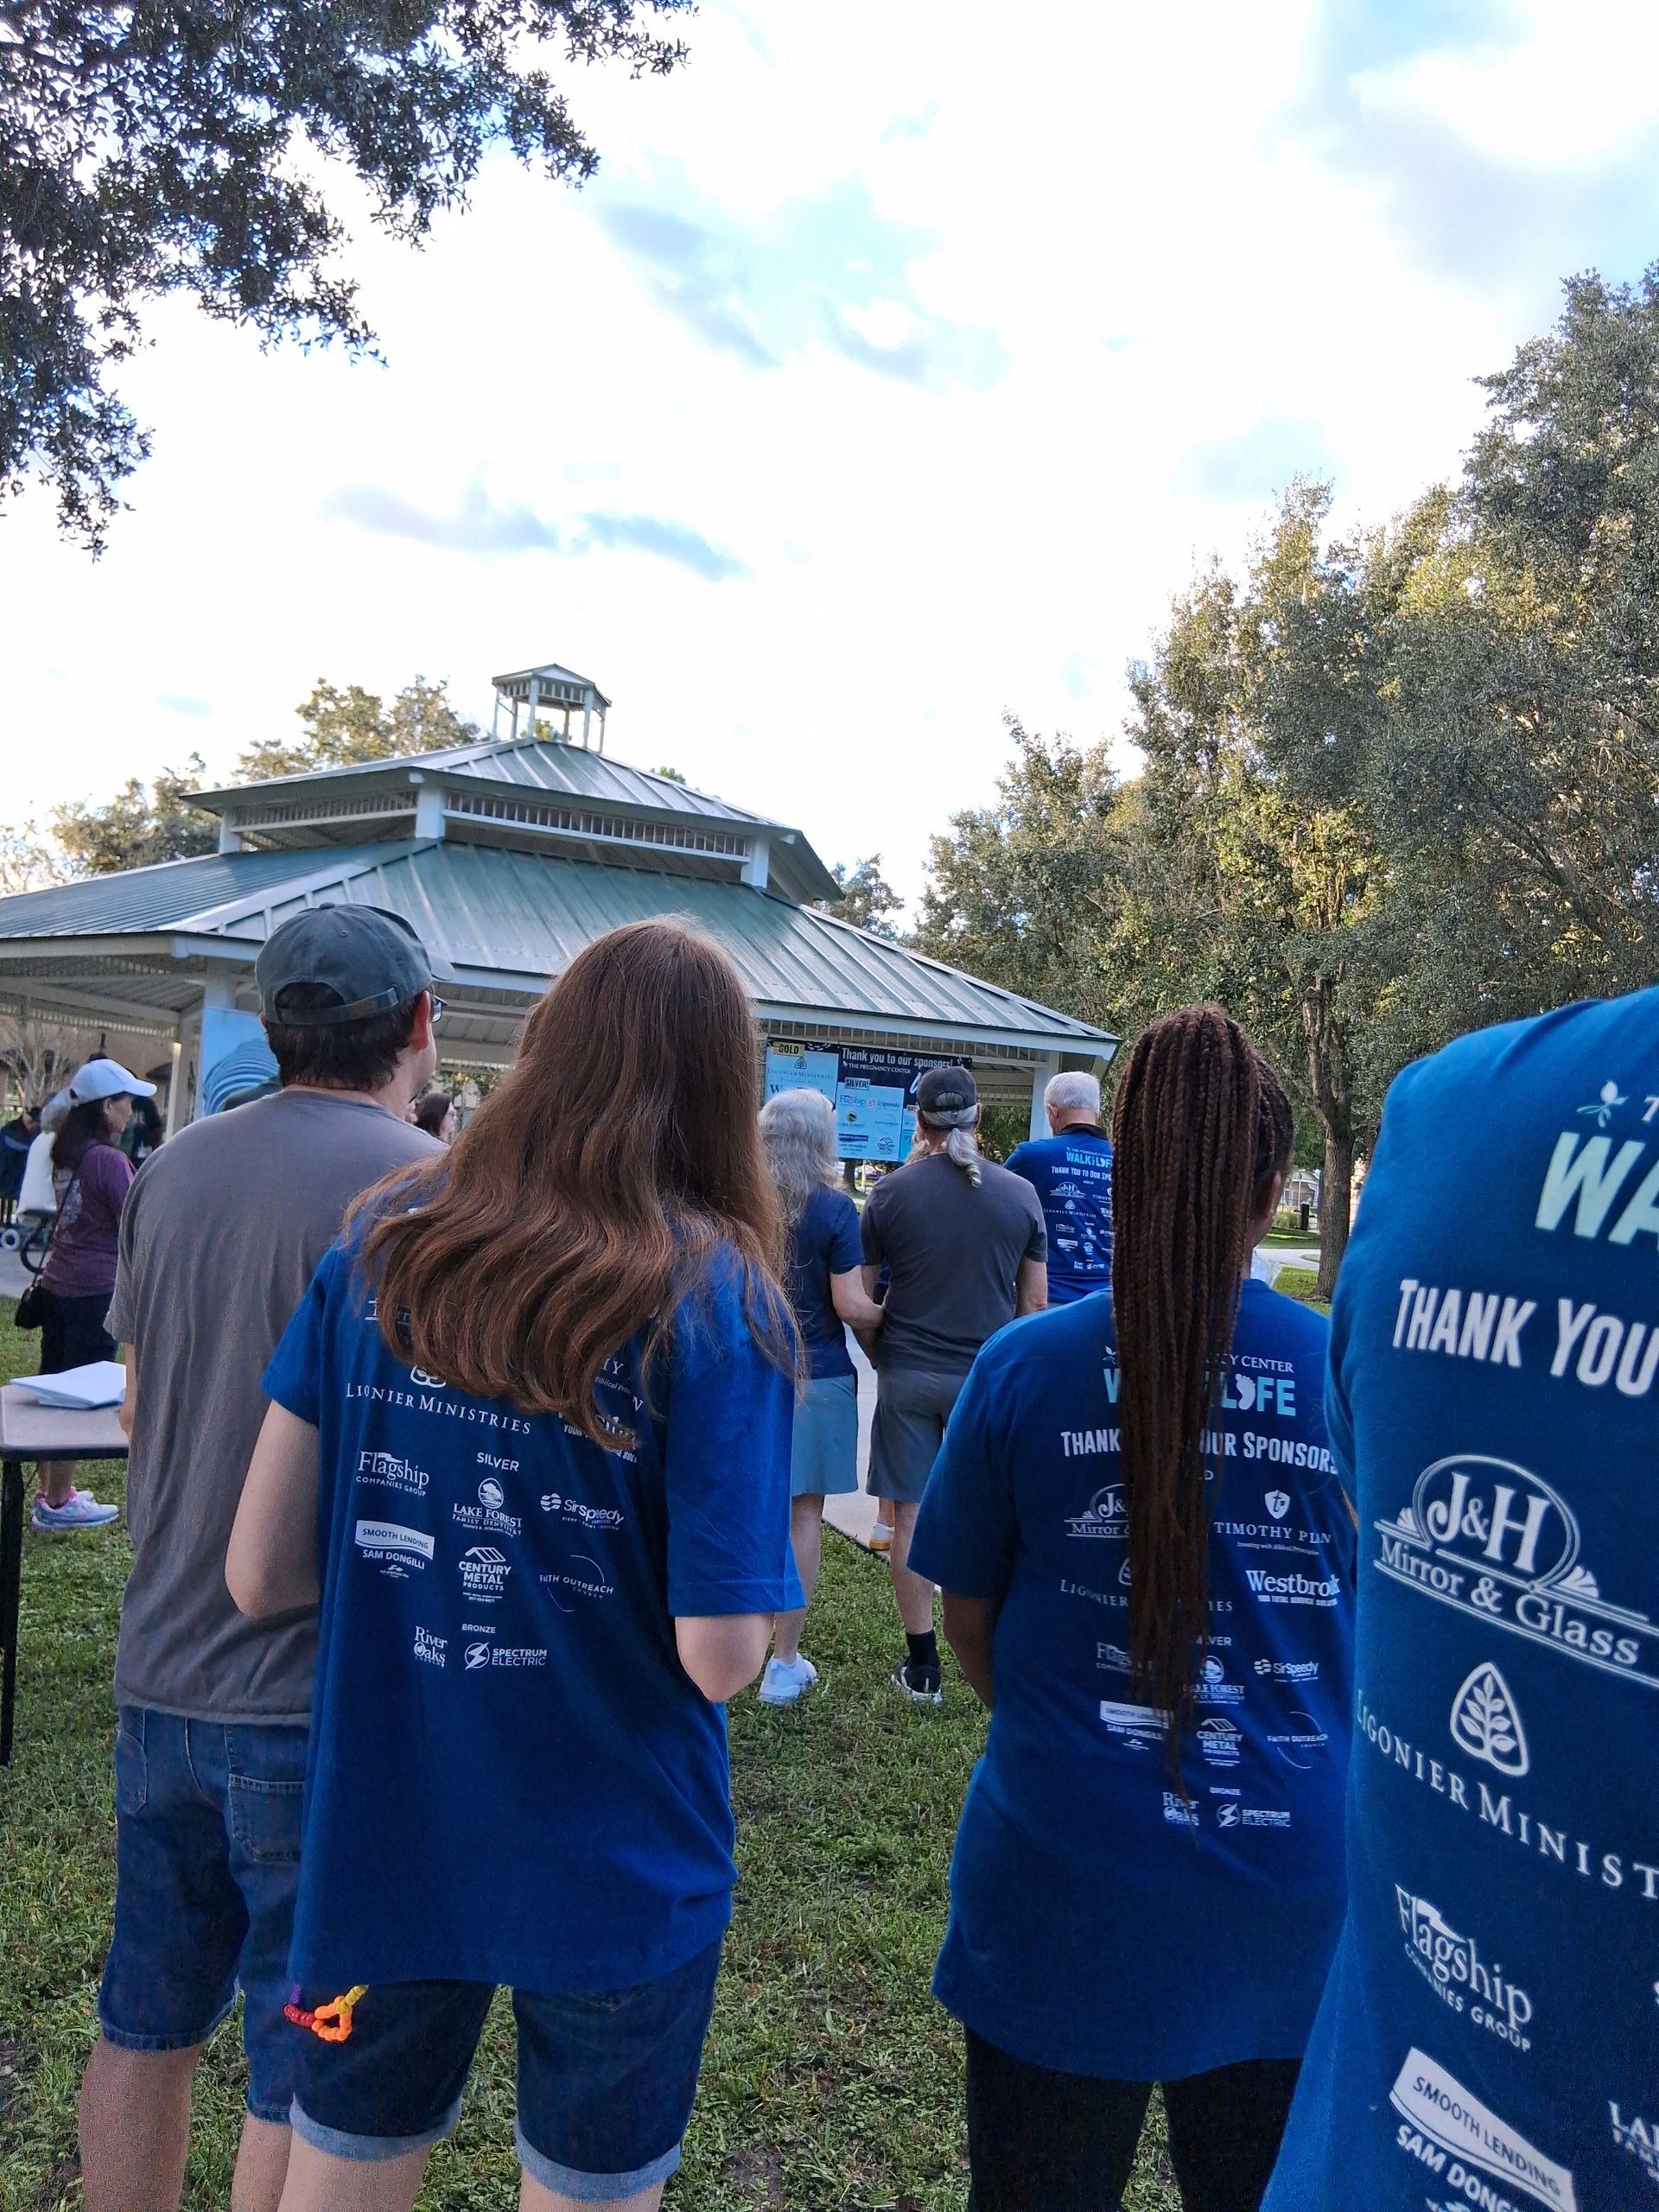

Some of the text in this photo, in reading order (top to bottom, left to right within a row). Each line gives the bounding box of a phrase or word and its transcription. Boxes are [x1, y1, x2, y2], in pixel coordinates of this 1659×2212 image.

[779, 1044, 799, 1054] GOLD
[842, 1047, 868, 1060] Thank
[869, 1052, 885, 1064] you
[887, 1055, 896, 1064] to
[898, 1057, 912, 1065] our
[860, 1064, 891, 1072] PREGNANCY
[1066, 1151, 1091, 1166] WALK
[1051, 1166, 1070, 1174] THANK
[1071, 1166, 1081, 1176] YOU
[1090, 1171, 1101, 1179] OUR
[1535, 1131, 1659, 1253] WA
[1392, 1279, 1659, 1396] THANK YOU
[1241, 1356, 1294, 1373] CENTER
[418, 1394, 531, 1434] MINISTRIES
[1060, 1428, 1122, 1458] THANK
[358, 1451, 429, 1489] Flagship
[477, 1452, 519, 1471] SILVER
[356, 1476, 426, 1497] COMPANIES GROUP
[1098, 1492, 1127, 1518] J&
[452, 1513, 480, 1524] FAMILY
[454, 1503, 523, 1528] LAKE FOREST
[1427, 1471, 1552, 1573] J&H
[362, 1528, 429, 1549] SMOOTH LENDING
[1071, 1522, 1121, 1535] Mirror
[1214, 1522, 1293, 1539] TIMOTHY
[363, 1548, 425, 1570] SAM DONGILLI
[458, 1560, 512, 1576] CENTURY
[462, 1581, 505, 1591] PRODUCTS
[463, 1572, 504, 1585] METAL
[563, 1576, 614, 1595] OUTREACH
[1245, 1569, 1341, 1597] Westbrok
[1382, 1534, 1640, 1666] Mirror & Glass
[415, 1625, 448, 1649] River
[461, 1623, 496, 1634] BRONZE
[413, 1642, 446, 1664] Oaks
[492, 1656, 547, 1667] ELECTRIC
[493, 1648, 548, 1657] SPECTRUM
[1196, 1731, 1243, 1742] CENTURY
[1202, 1740, 1238, 1751] METAL
[1357, 1688, 1659, 1899] LIGONIER MINIST
[1242, 1818, 1292, 1827] ELECTRIC
[1395, 1883, 1533, 2031] Flagship
[1471, 2005, 1531, 2054] GROUP
[1413, 2075, 1480, 2139] SMOOTH
[1484, 2128, 1561, 2198] LENDING
[1396, 2124, 1519, 2212] SAM DONG
